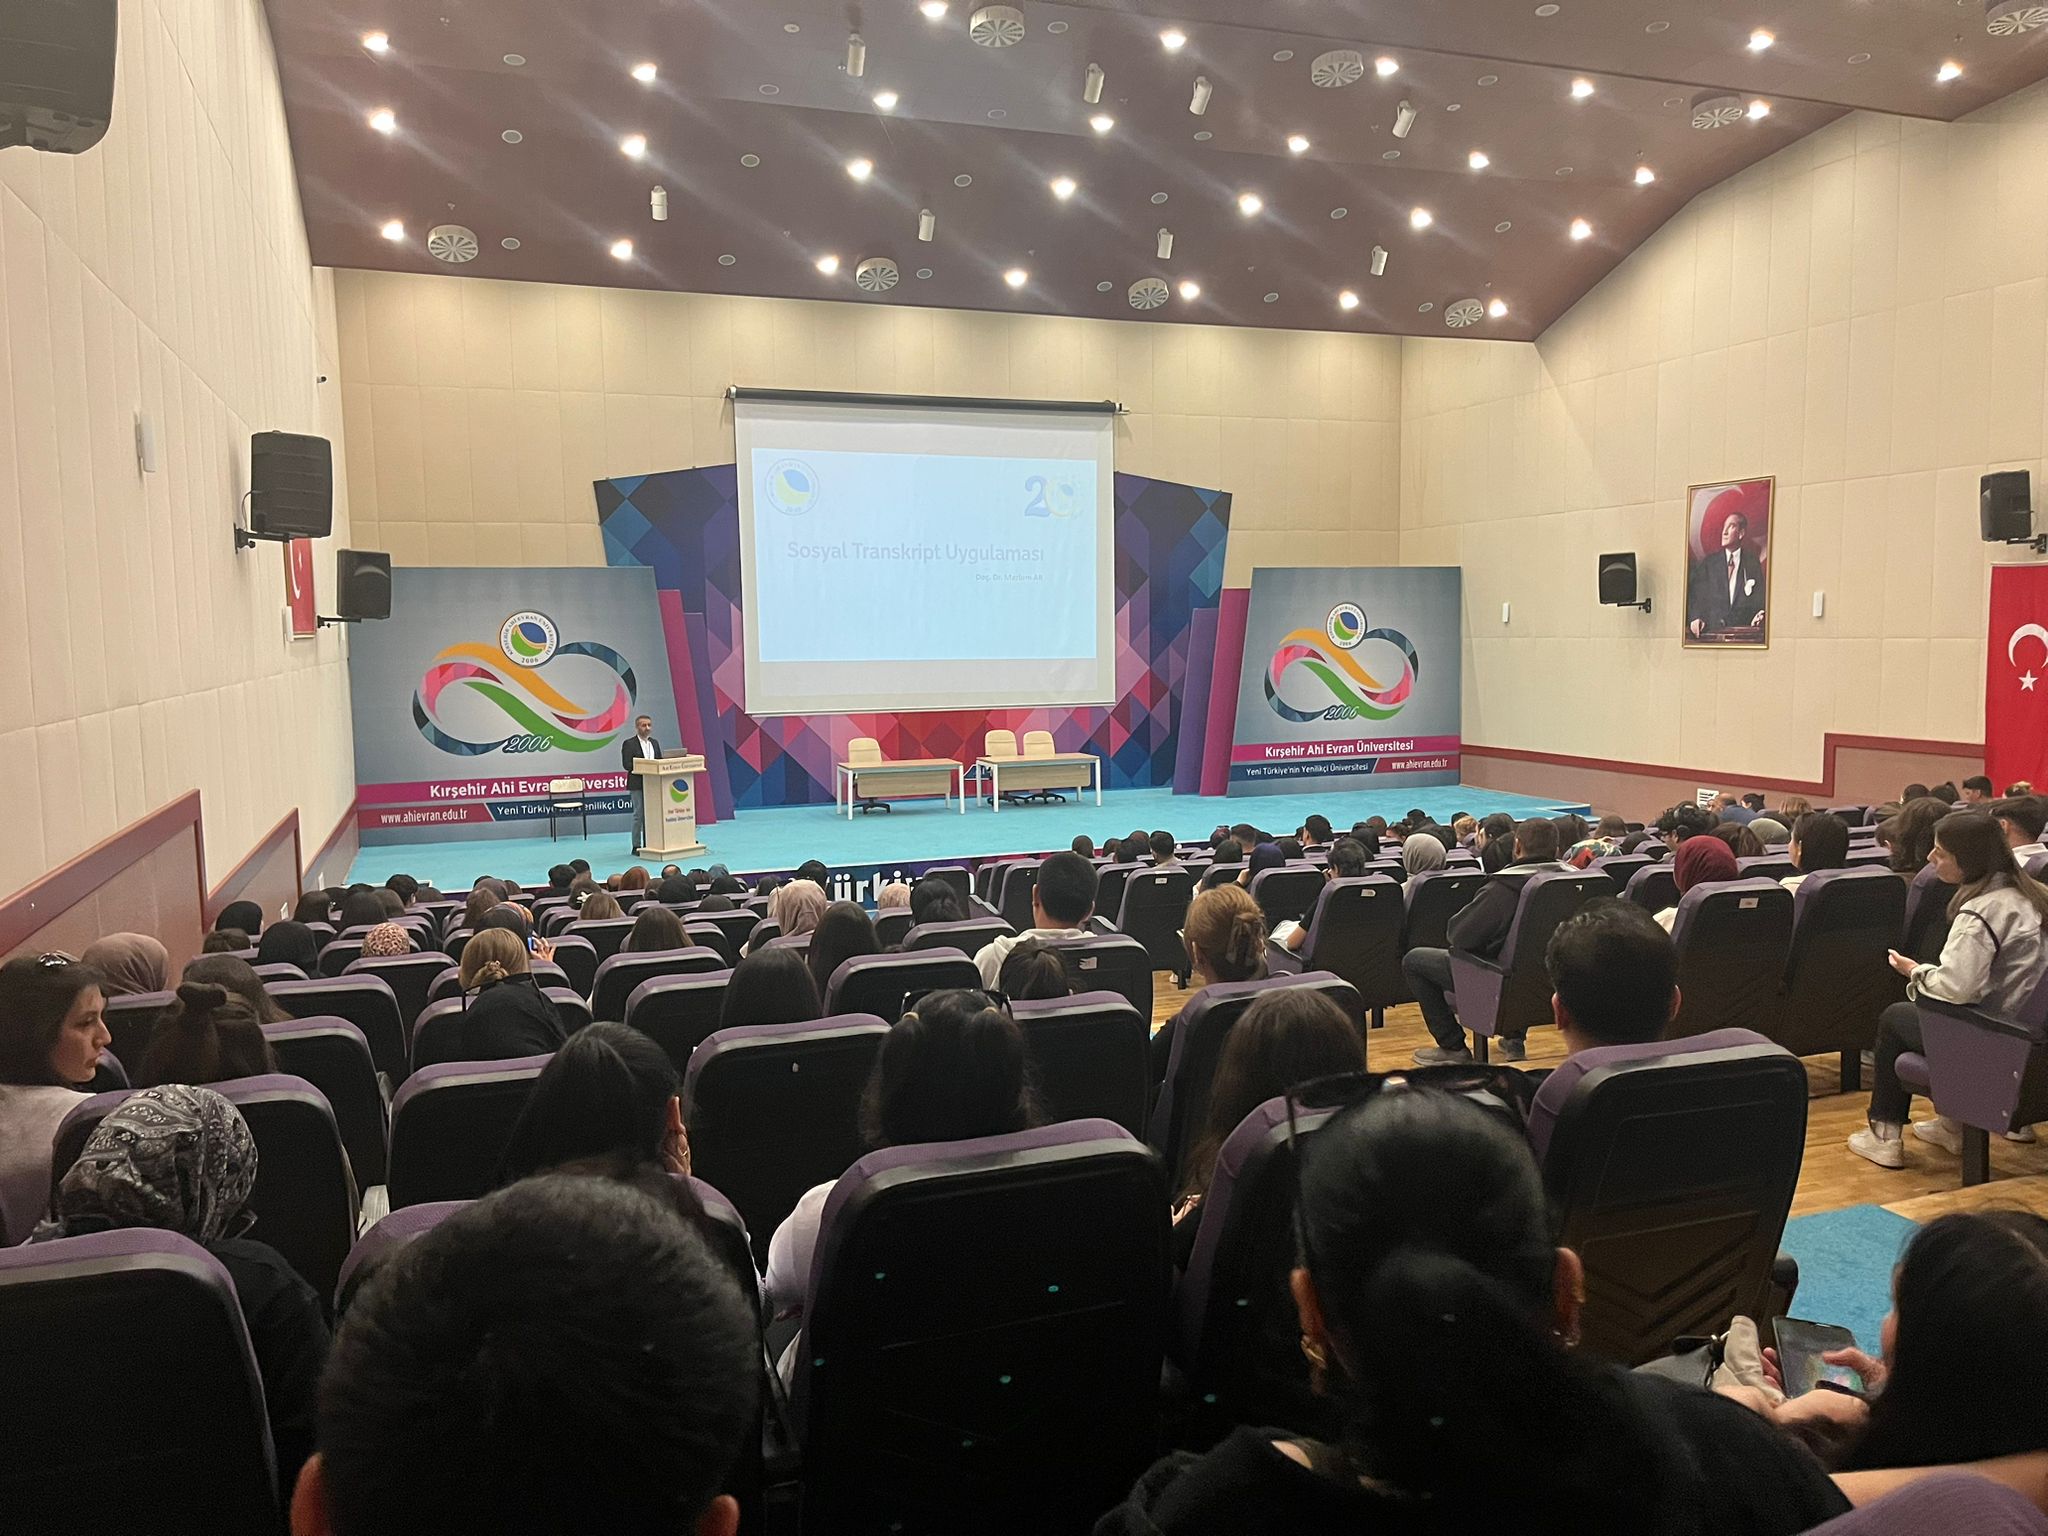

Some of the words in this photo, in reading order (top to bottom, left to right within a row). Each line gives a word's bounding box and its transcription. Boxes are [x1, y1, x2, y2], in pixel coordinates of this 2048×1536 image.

[787, 541, 848, 564] Sosyal
[851, 542, 941, 565] Transkript
[946, 543, 1044, 565] Uygulaması
[1325, 705, 1360, 719] 2006
[505, 735, 554, 751] 2006
[1265, 744, 1305, 758] Kırşehir
[1307, 743, 1325, 755] Ahi
[1326, 743, 1355, 754] Evran
[1356, 740, 1414, 753] Üniversitesi
[1246, 768, 1262, 776] Yeni
[1262, 765, 1301, 776] Türkiye'nin
[1301, 764, 1329, 773] Yenilikçi
[1329, 762, 1369, 772] Üniversitesi
[1391, 758, 1448, 770] www.ahievran.edu.tr
[430, 782, 487, 798] Kırşehir
[490, 781, 515, 795] Ahi
[519, 779, 550, 793] Evra
[381, 807, 468, 825] www.ahievran.edu.tr
[497, 805, 519, 816] Yeni
[578, 799, 615, 811] enilikçi
